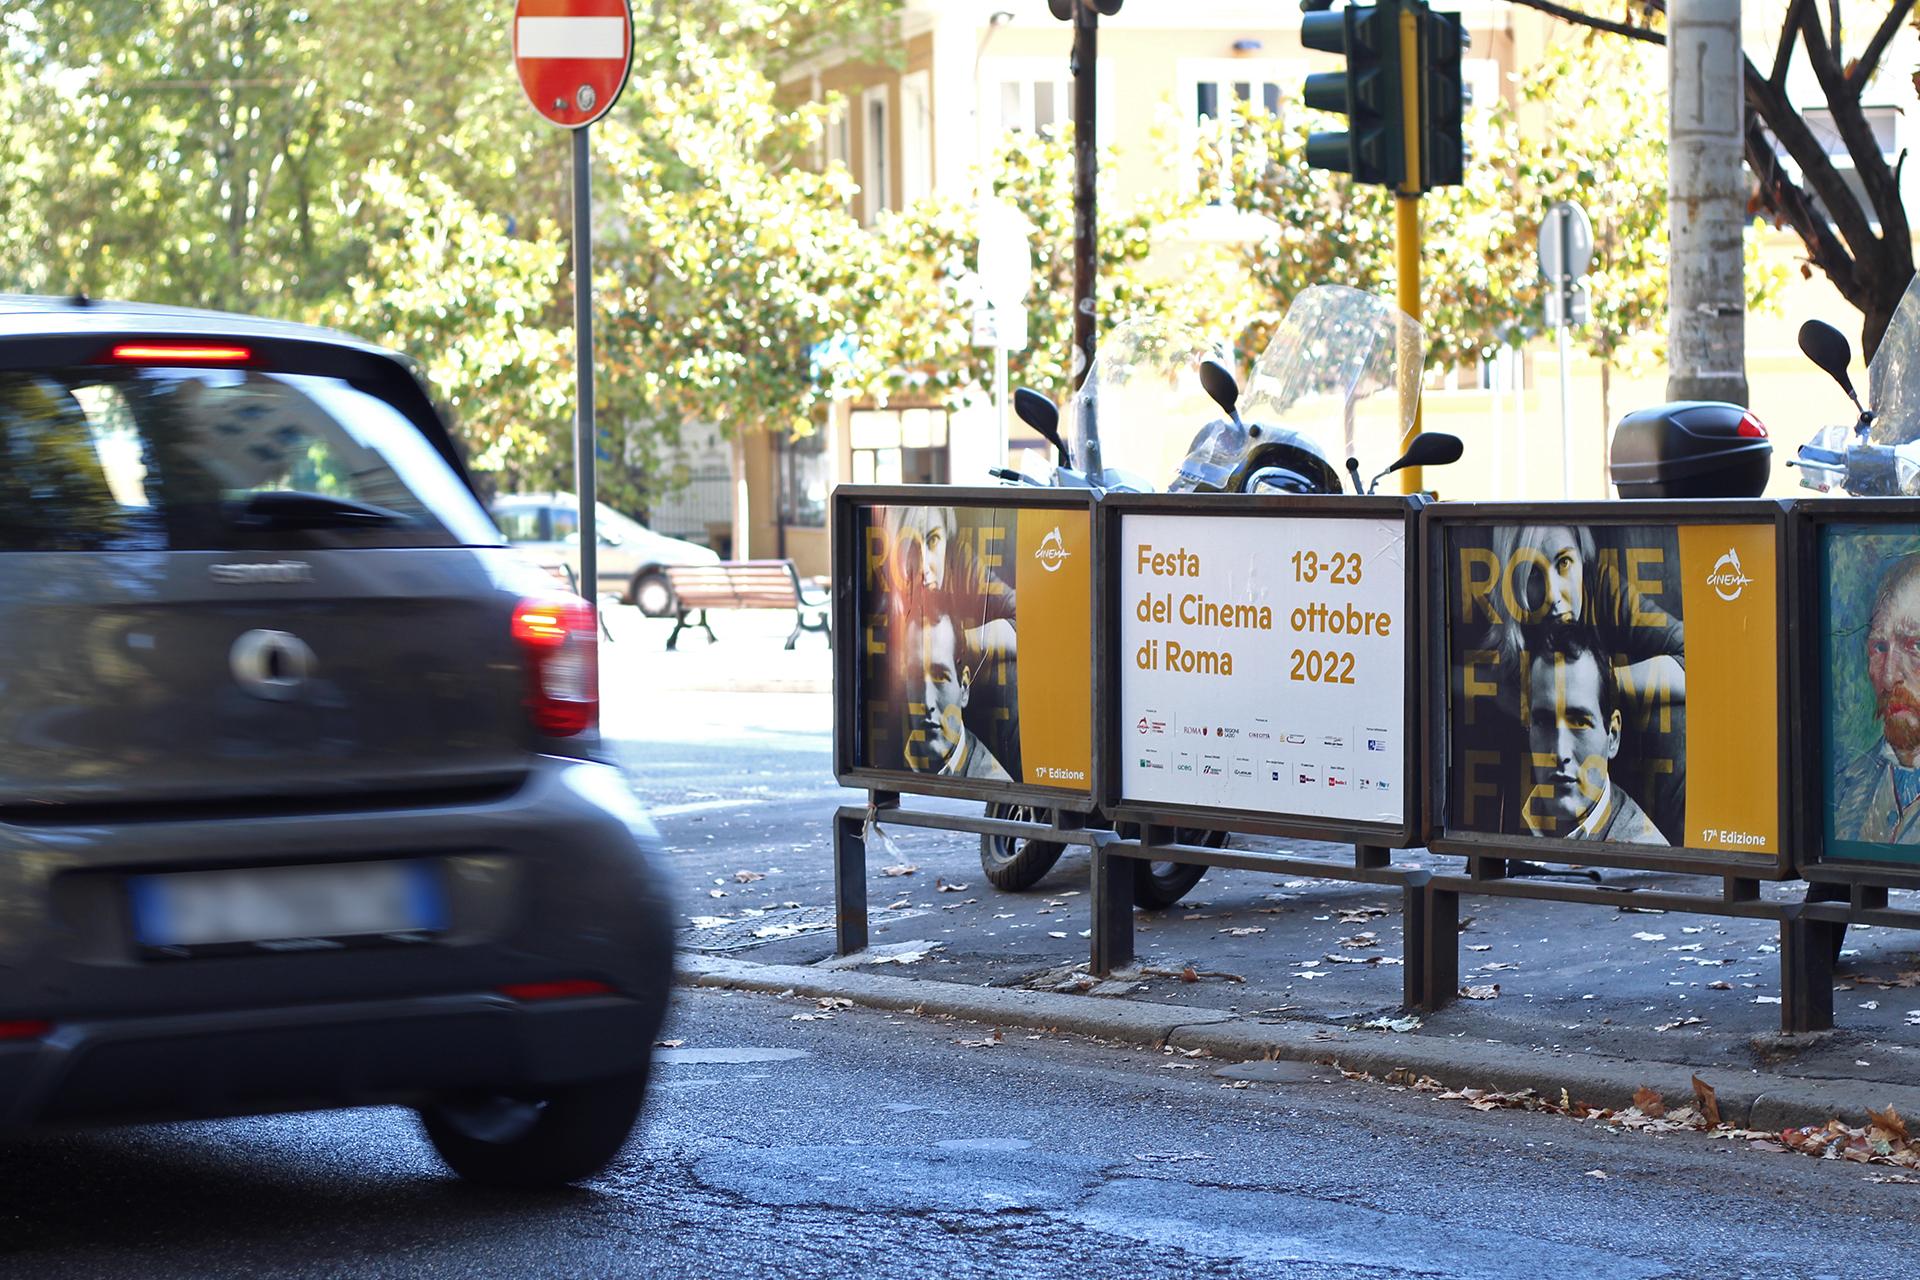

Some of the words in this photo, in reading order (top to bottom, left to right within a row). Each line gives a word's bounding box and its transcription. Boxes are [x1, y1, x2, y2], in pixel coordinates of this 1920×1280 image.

[1136, 544, 1200, 577] Festa
[1291, 551, 1363, 585] 13-23
[1459, 548, 1667, 627] ROME
[1136, 592, 1172, 624] del
[1179, 594, 1272, 630] Cinema
[1290, 602, 1392, 637] ottobre
[1136, 640, 1158, 670] di
[1165, 641, 1233, 676] Roma
[1290, 649, 1356, 685] 2022
[1049, 768, 1084, 780] Edizione
[1720, 830, 1766, 846] Edizione
